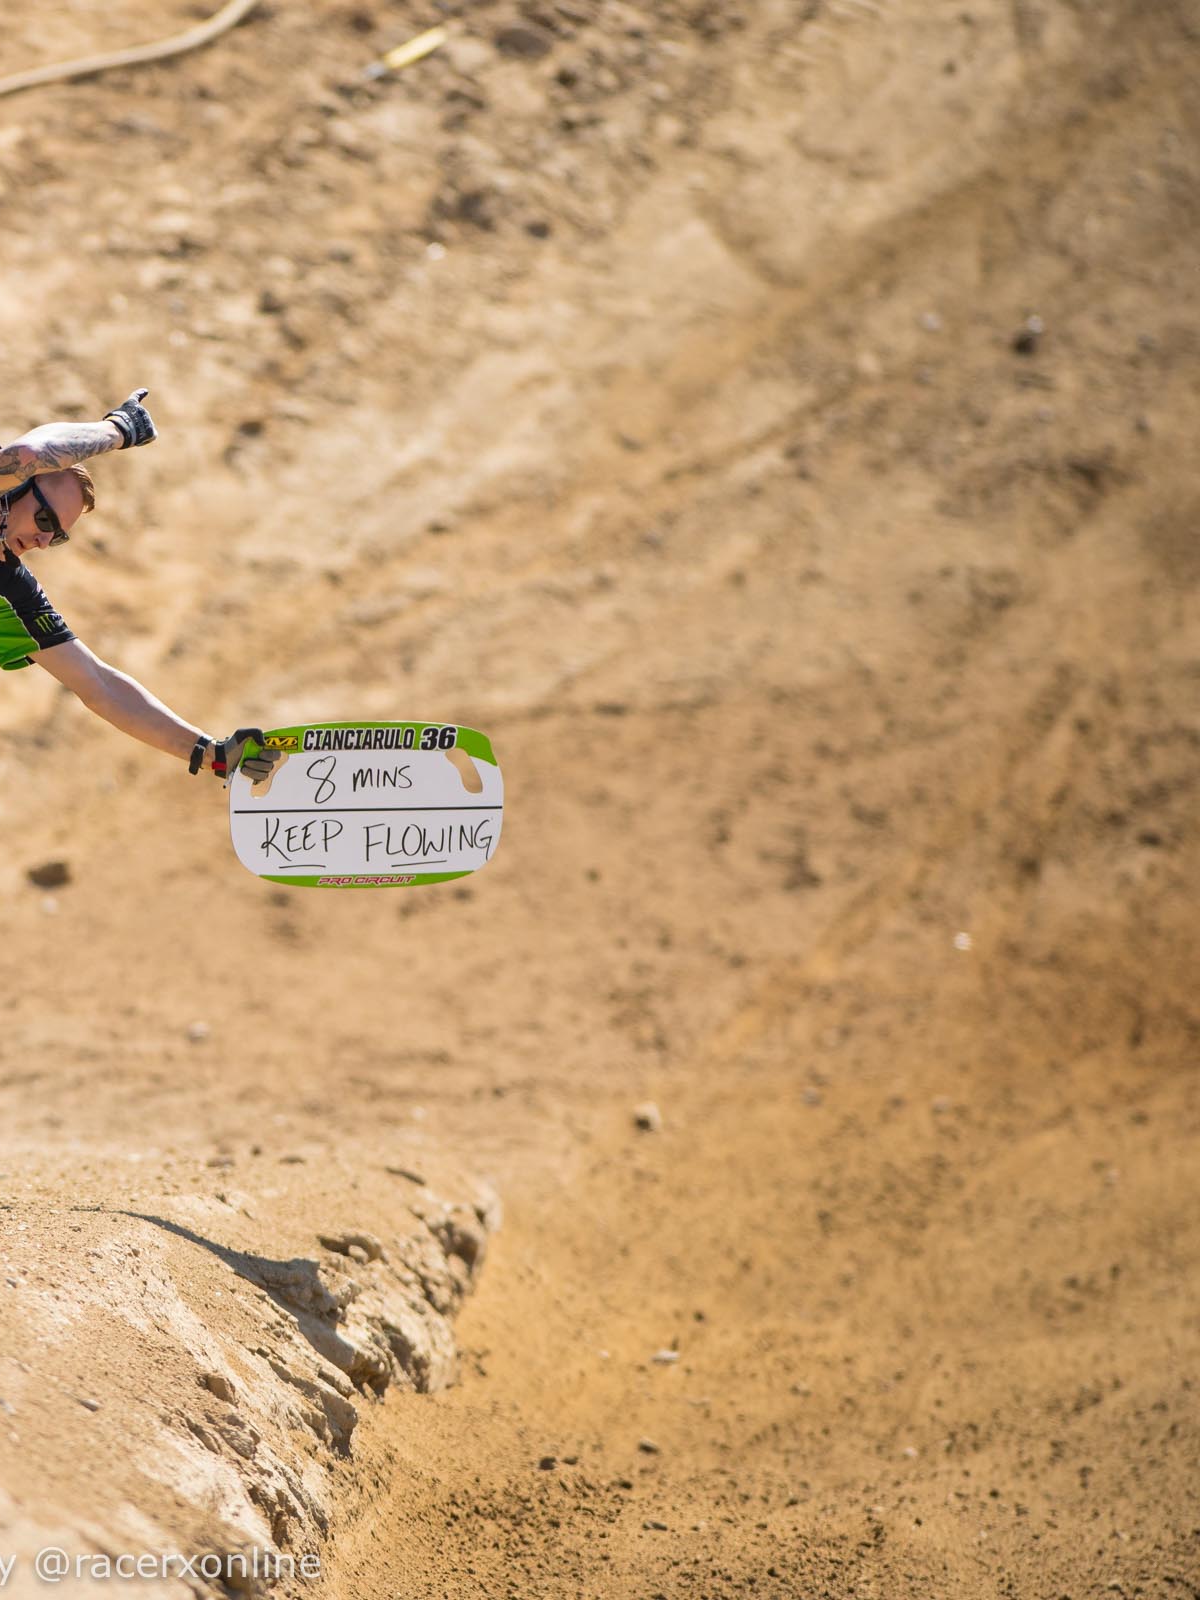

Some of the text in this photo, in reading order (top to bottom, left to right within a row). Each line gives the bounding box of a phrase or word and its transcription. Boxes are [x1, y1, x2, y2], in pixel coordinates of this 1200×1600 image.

[303, 728, 415, 751] CIANCIARULO
[420, 726, 457, 750] 36
[306, 755, 413, 804] 8 MINS
[260, 817, 493, 862] KEEP FLOWING
[318, 875, 416, 886] PRO CIRCUIT
